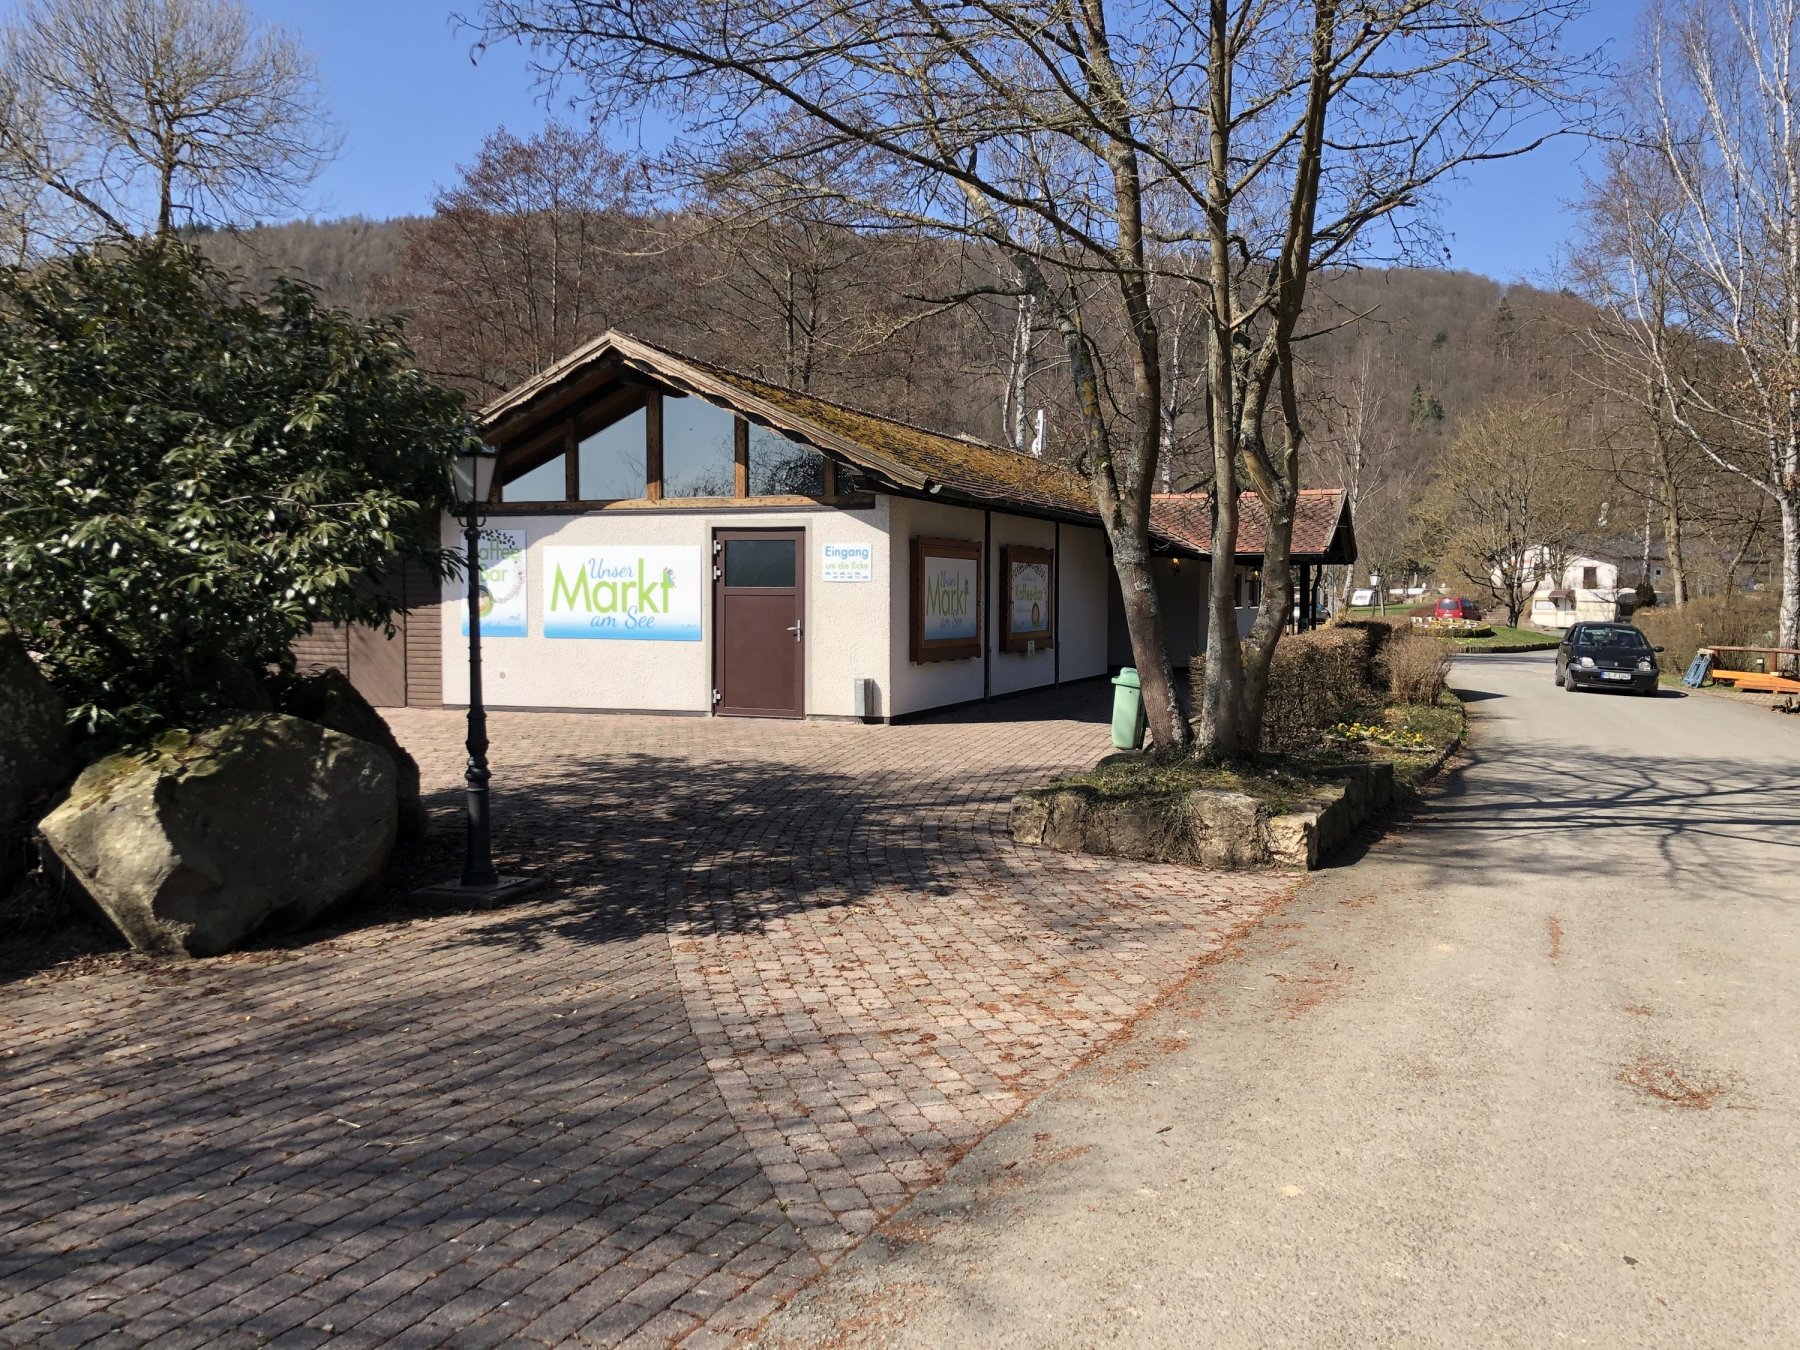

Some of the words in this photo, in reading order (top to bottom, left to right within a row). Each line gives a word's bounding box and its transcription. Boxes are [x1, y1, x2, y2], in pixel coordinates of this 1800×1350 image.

[478, 539, 520, 560] affee
[825, 545, 869, 560] Eingang
[588, 558, 635, 579] Unser
[838, 561, 849, 570] die
[851, 561, 868, 570] Ecke
[550, 558, 673, 613] Markt
[926, 570, 968, 616] Markt
[590, 615, 618, 628] am
[625, 605, 656, 630] See
